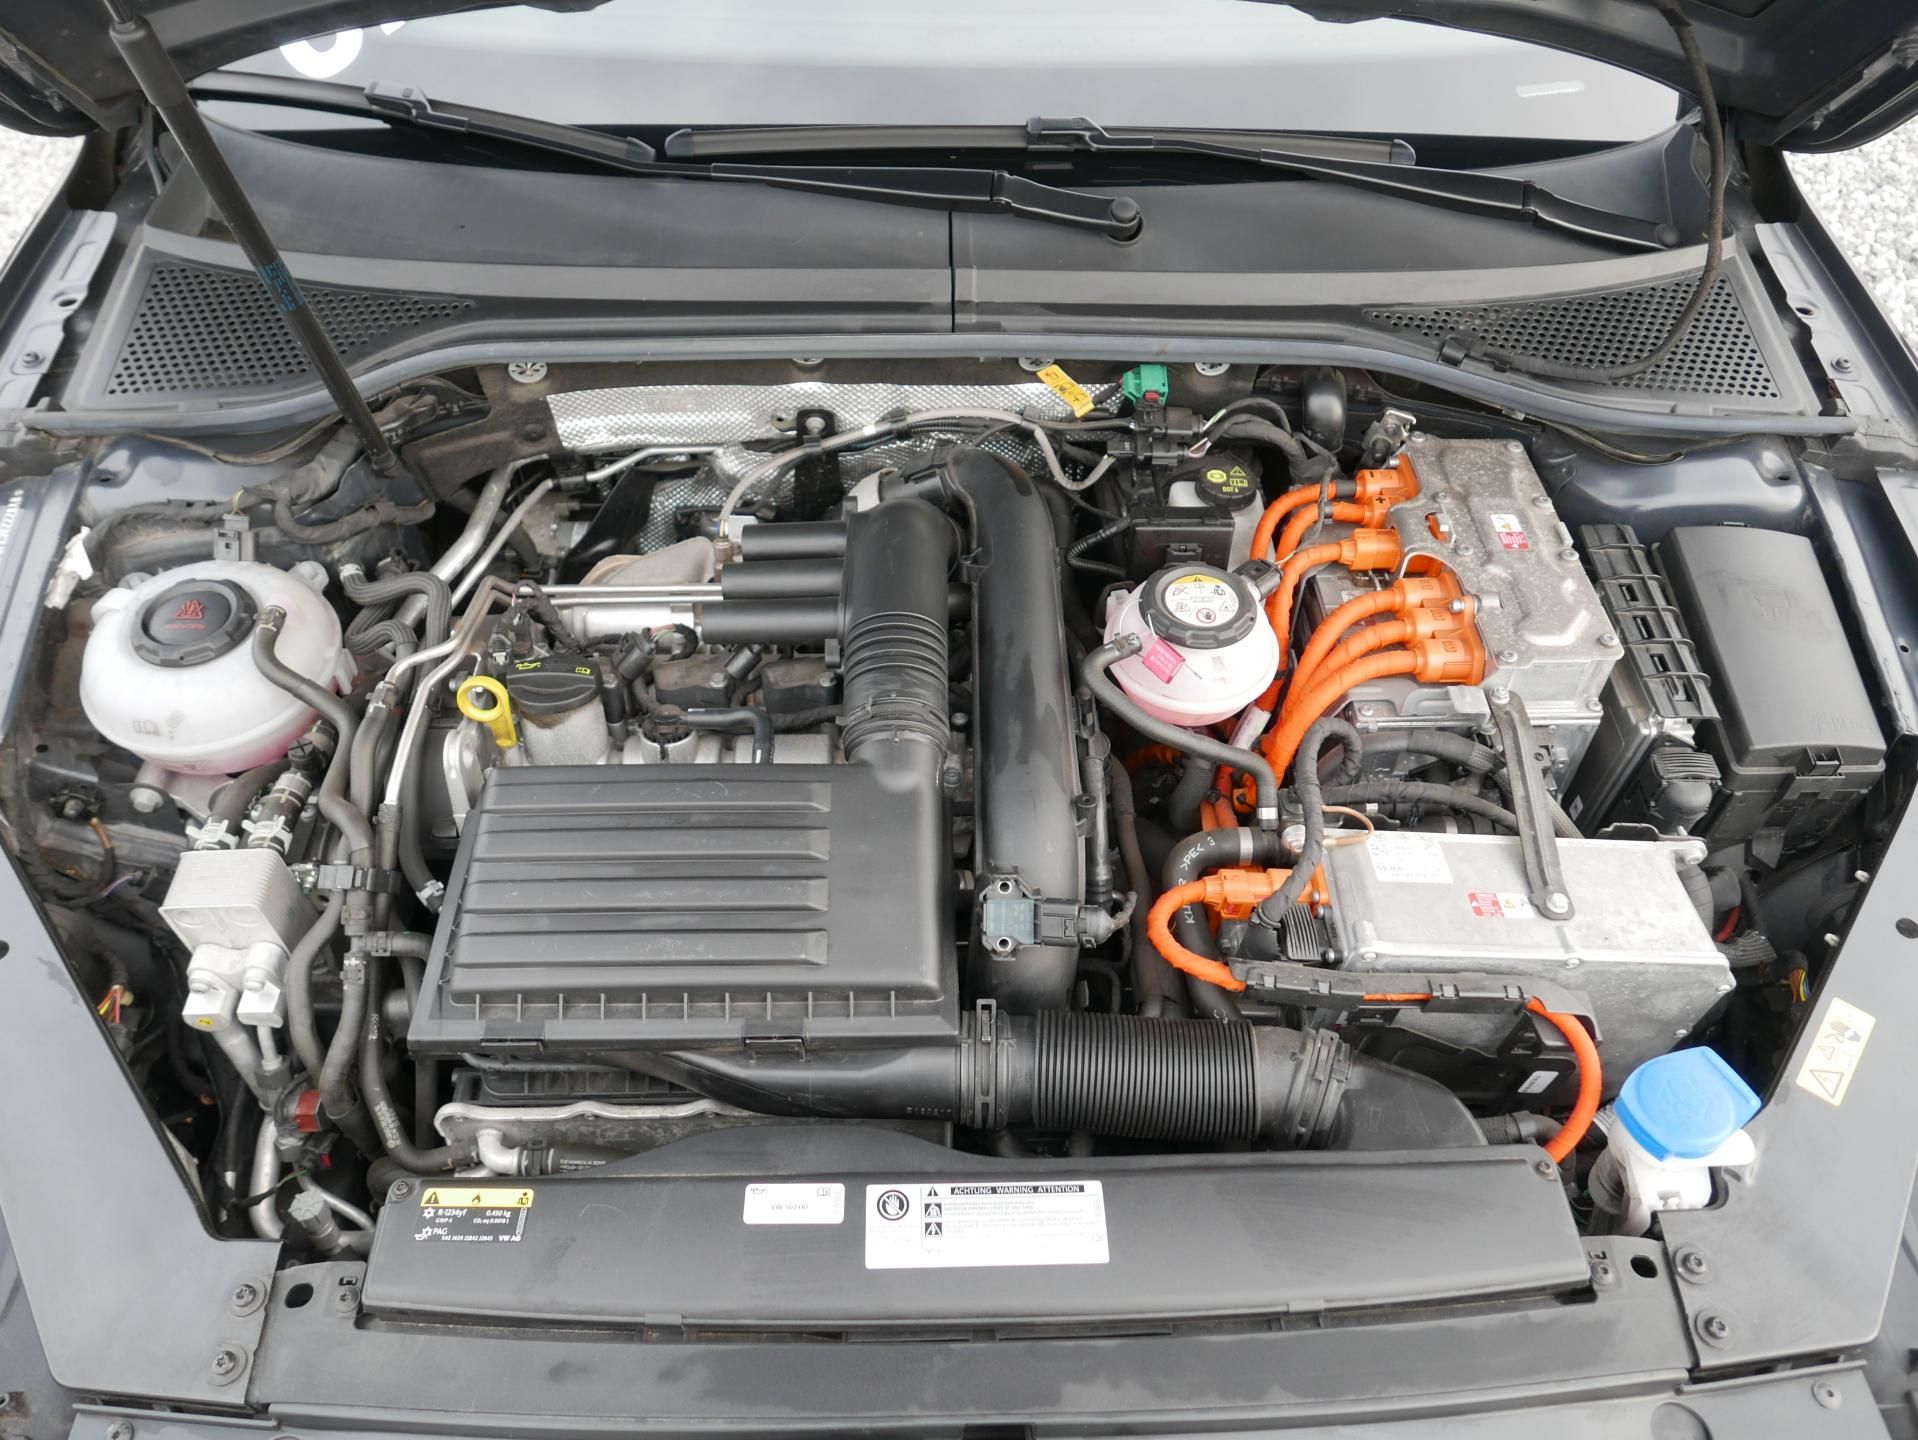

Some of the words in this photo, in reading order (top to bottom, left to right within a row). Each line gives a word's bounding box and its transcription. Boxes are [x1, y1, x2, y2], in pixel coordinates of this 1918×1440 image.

[996, 1186, 1034, 1194] WARNING
[1037, 1185, 1080, 1193] ATTENTION
[437, 1208, 468, 1217] R-1234yf
[503, 1210, 512, 1218] kg
[432, 1227, 448, 1235] PAG
